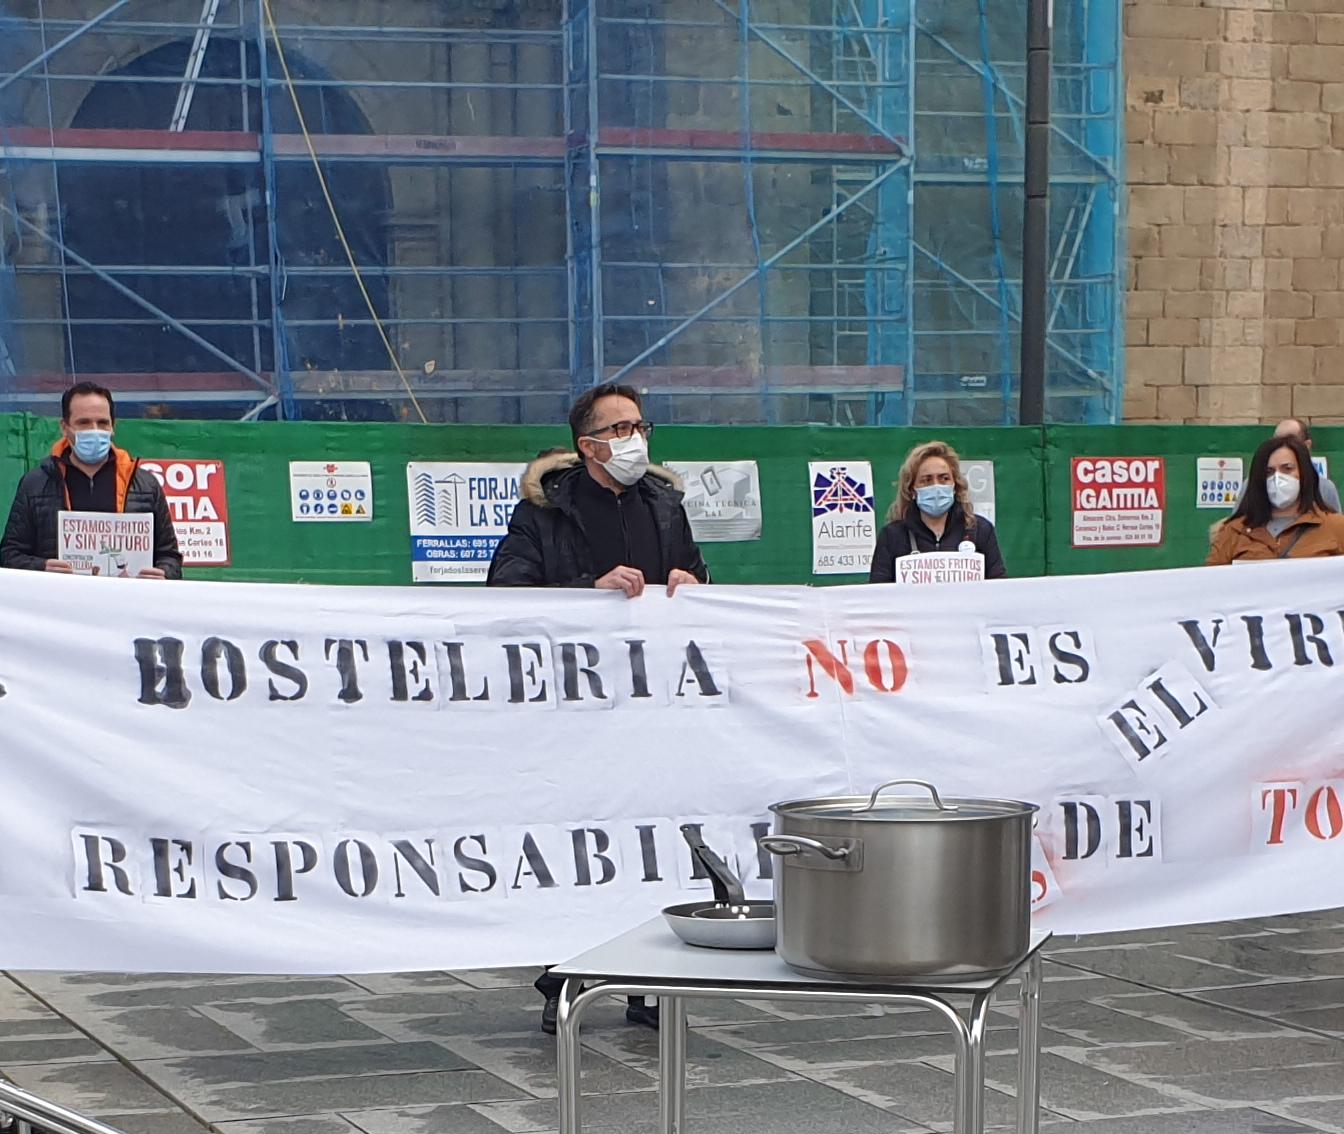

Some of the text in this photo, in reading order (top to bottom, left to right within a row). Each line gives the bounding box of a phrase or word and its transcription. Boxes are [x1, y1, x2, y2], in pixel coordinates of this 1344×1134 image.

[1076, 460, 1160, 483] casor
[468, 477, 519, 500] FORJA
[470, 503, 489, 527] LA
[63, 518, 150, 534] ESTAMOS FRITOS
[817, 519, 873, 538] Alarife
[63, 534, 150, 552] Y SIN FUTURO
[817, 555, 835, 567] 685
[837, 555, 854, 566] 433
[900, 558, 982, 571] ESTAMOS FRITOS
[900, 572, 908, 583] Y
[911, 570, 932, 584] SIN
[133, 635, 723, 709] HOSTELERIA
[801, 638, 910, 699] NO
[991, 630, 1091, 687] ES
[1106, 675, 1209, 763] EL
[1058, 799, 1154, 862] DE
